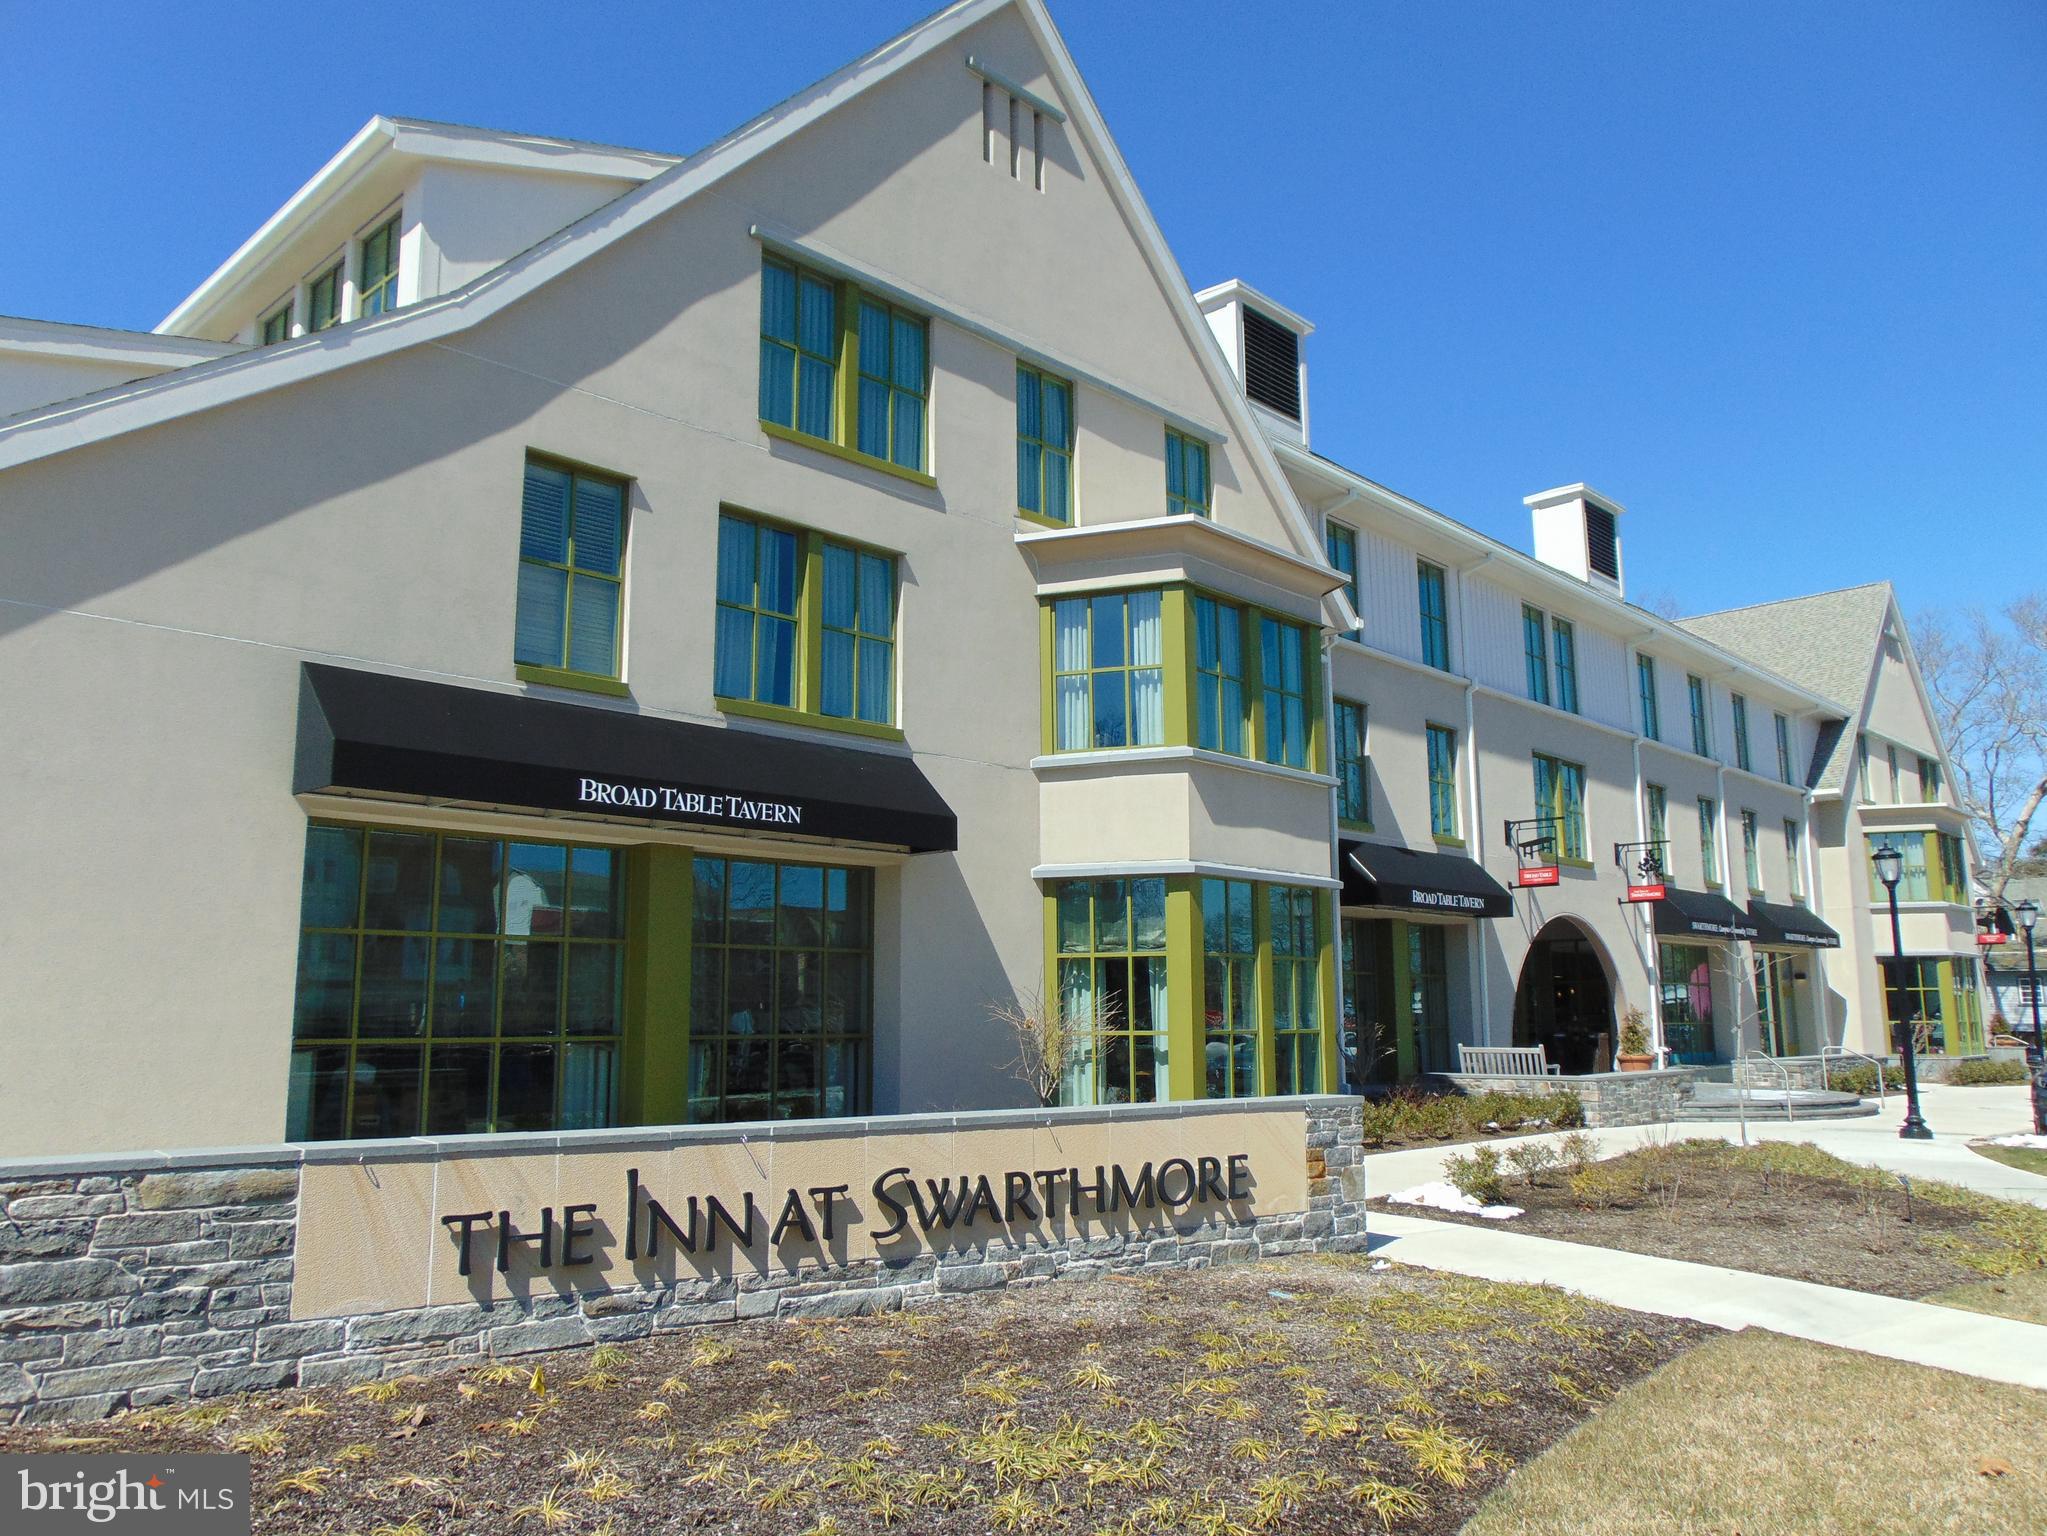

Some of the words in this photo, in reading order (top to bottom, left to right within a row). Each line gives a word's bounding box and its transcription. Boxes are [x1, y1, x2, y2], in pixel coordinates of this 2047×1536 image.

[578, 778, 657, 808] BROAD
[659, 786, 723, 816] TABLE
[725, 795, 802, 824] TAVERN
[1412, 889, 1437, 905] BROAD
[1437, 892, 1458, 907] TABLE
[1458, 894, 1485, 909] TAVERN
[441, 1203, 597, 1276] THE
[625, 1168, 753, 1261] INN
[770, 1183, 849, 1245] AT
[869, 1153, 1249, 1239] SWARTHMORE
